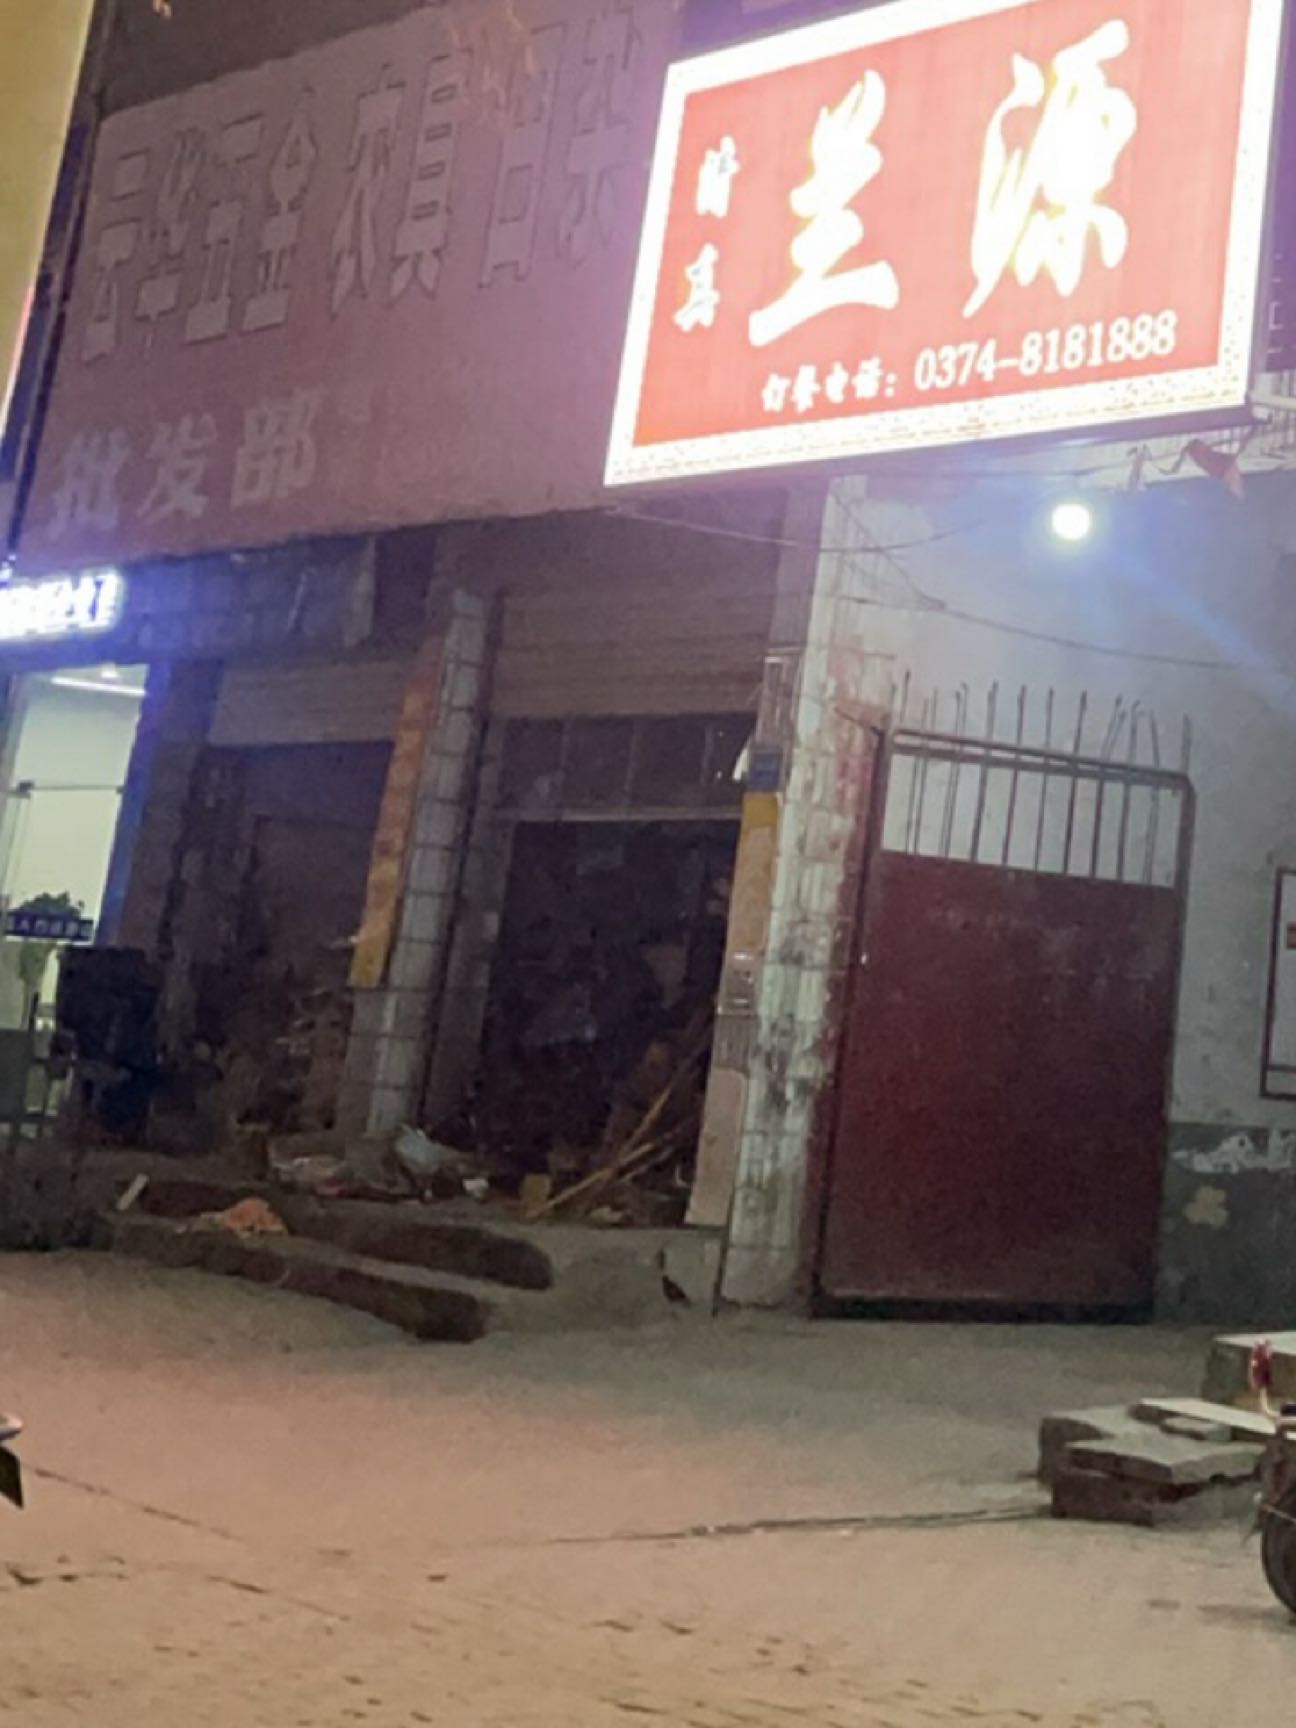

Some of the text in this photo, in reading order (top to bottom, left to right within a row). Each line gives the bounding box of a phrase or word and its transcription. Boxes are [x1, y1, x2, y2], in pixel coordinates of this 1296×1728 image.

[673, 134, 741, 332] 清真
[748, 18, 1138, 347] 兰源
[46, 384, 328, 540] 批发部
